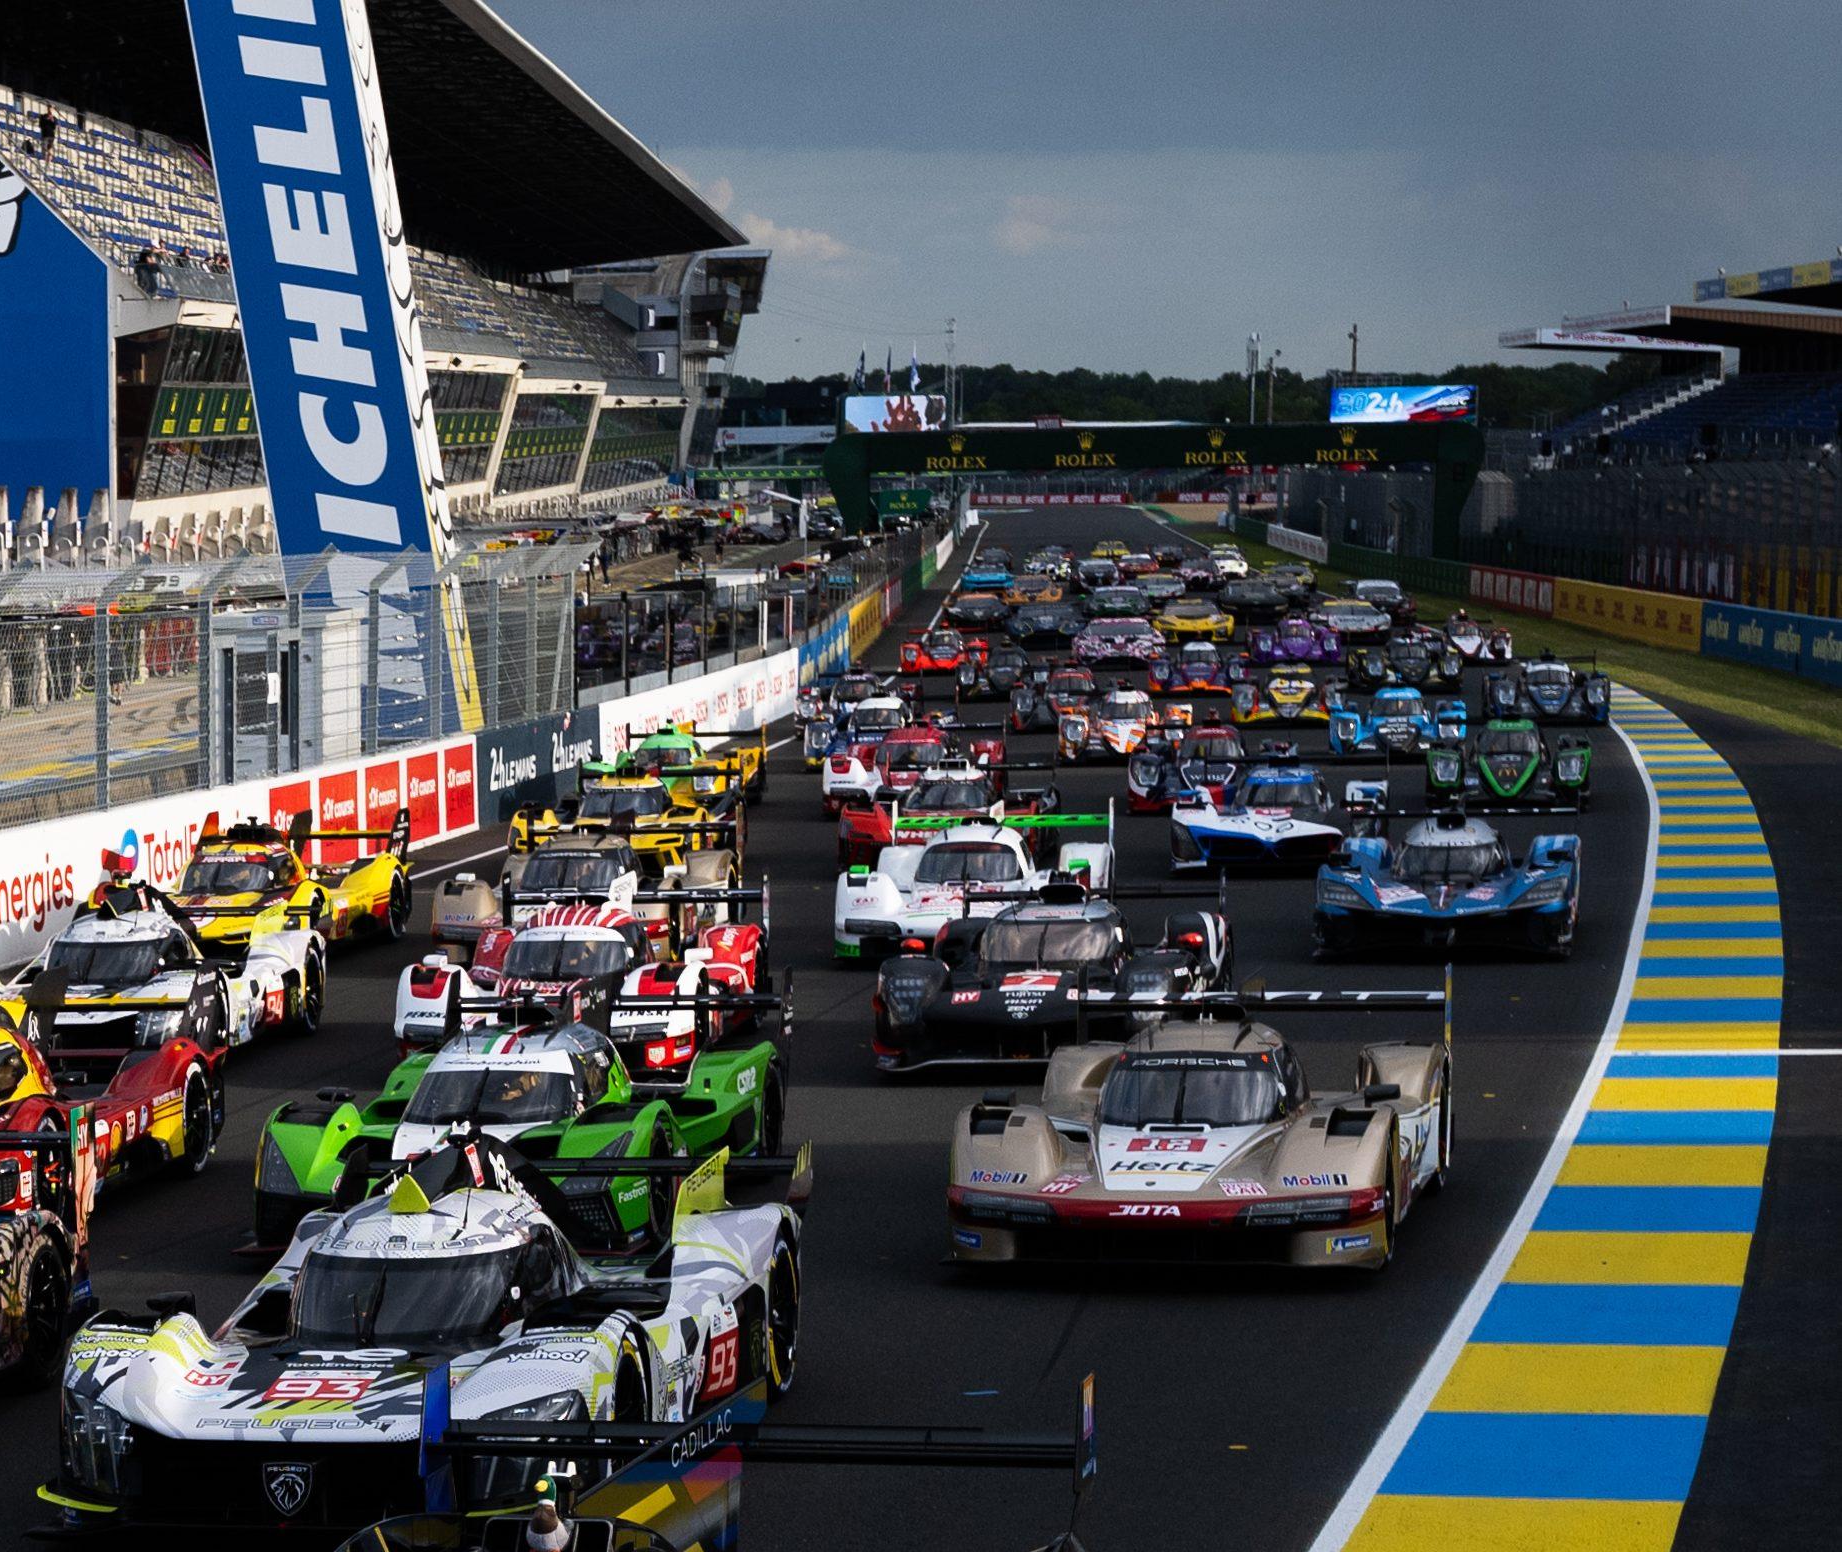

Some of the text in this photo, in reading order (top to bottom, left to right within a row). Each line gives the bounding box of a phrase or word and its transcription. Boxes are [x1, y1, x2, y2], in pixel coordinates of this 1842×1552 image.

[231, 0, 429, 735] MICHELI
[925, 455, 987, 470] ROLEX
[1054, 452, 1117, 468] ROLEX
[1184, 450, 1247, 466] ROLEX
[1315, 447, 1379, 463] ROLEX
[516, 753, 537, 783] MANS
[1019, 974, 1049, 987] 7
[953, 991, 980, 1003] HY
[1007, 1005, 1038, 1013] ZENT
[443, 1057, 542, 1067] Lamborghini
[1131, 1056, 1248, 1068] PORSCHE
[684, 1153, 725, 1195] PEUGEOT
[1109, 1159, 1218, 1175] Hertz
[969, 1169, 1012, 1184] Mobil
[1282, 1173, 1332, 1187] Mobil
[618, 1184, 649, 1204] Fastron
[1041, 1180, 1078, 1194] HY
[1108, 1204, 1182, 1217] JOTA
[517, 1335, 582, 1347] Capgemini
[71, 1347, 141, 1362] yahoo!
[507, 1349, 590, 1364] yahoo!
[286, 1361, 395, 1369] TotalEnergies
[707, 1337, 737, 1392] 93
[188, 1371, 229, 1386] HY
[273, 1379, 361, 1399] 93
[195, 1417, 397, 1430] PEUGEOT
[670, 1408, 733, 1469] CADILLAC
[267, 1465, 308, 1474] PEUGEOT
